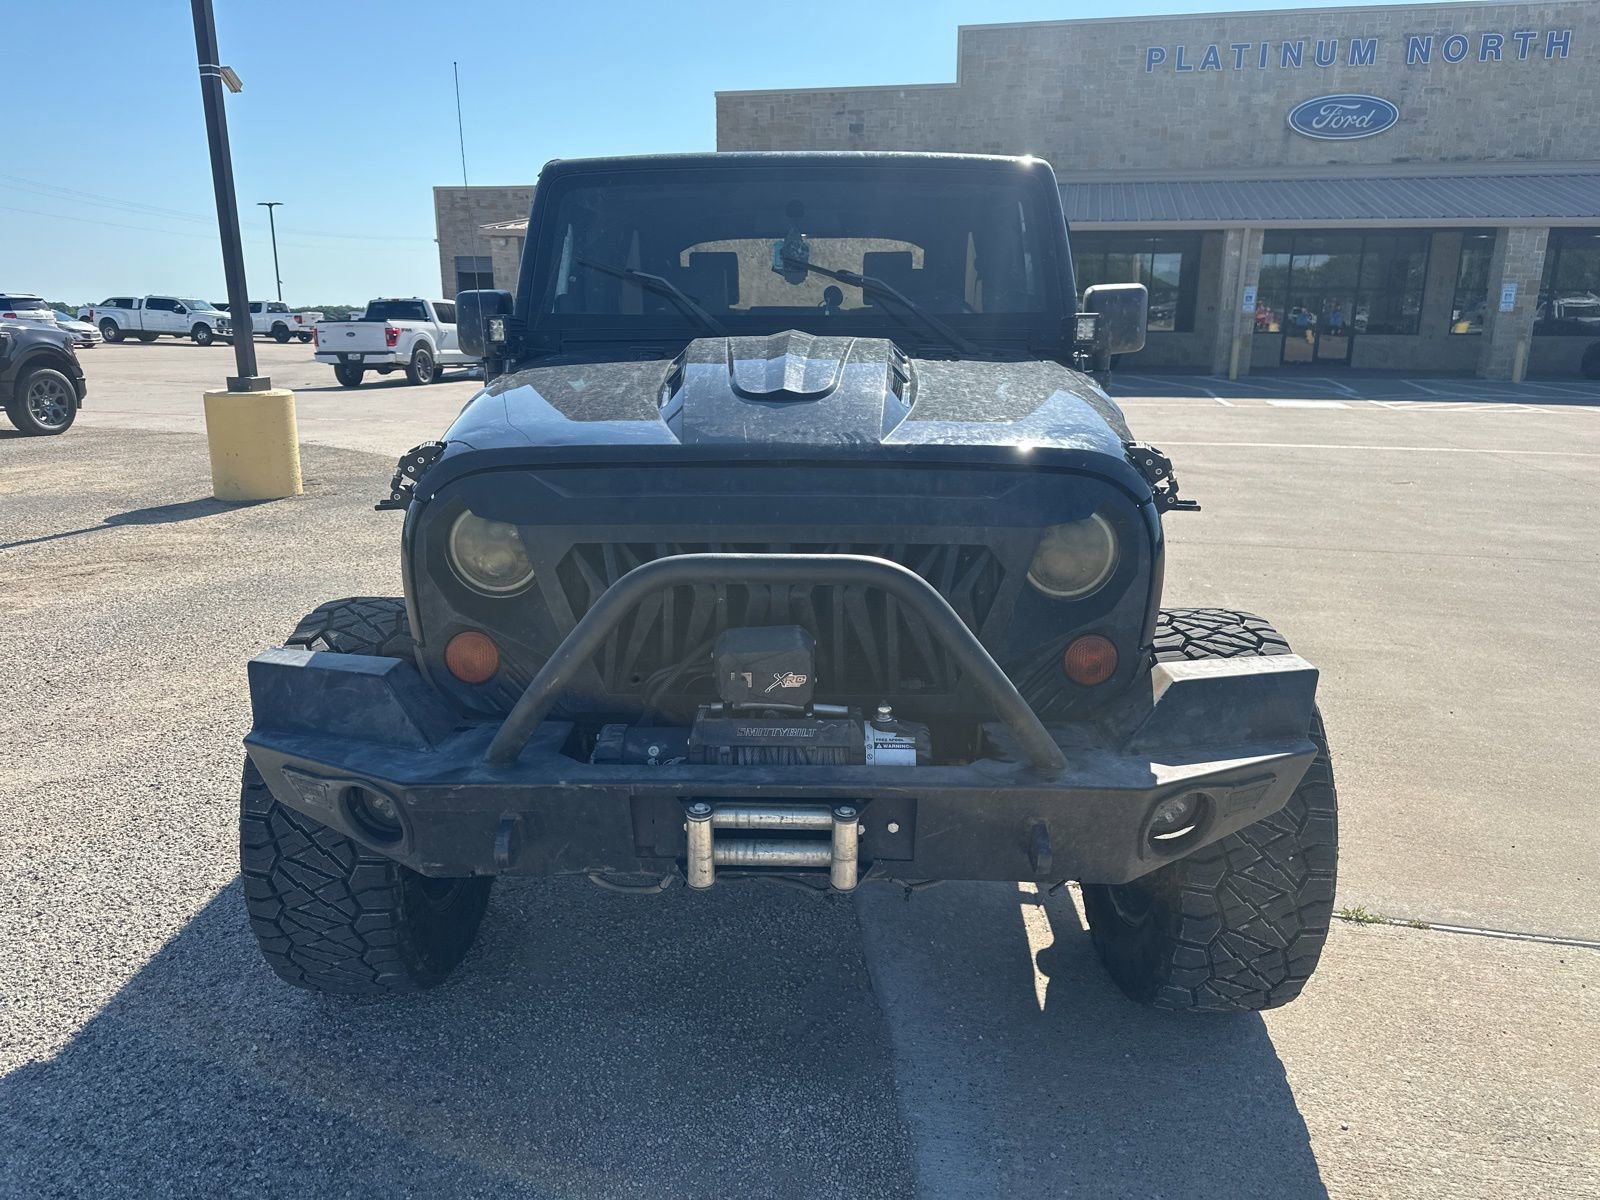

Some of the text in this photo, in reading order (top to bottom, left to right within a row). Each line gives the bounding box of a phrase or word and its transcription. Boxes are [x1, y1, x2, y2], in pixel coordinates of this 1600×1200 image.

[1145, 30, 1572, 73] PLATINUM NORTH
[1312, 103, 1376, 129] Ford
[736, 727, 817, 737] SMITTYBILT
